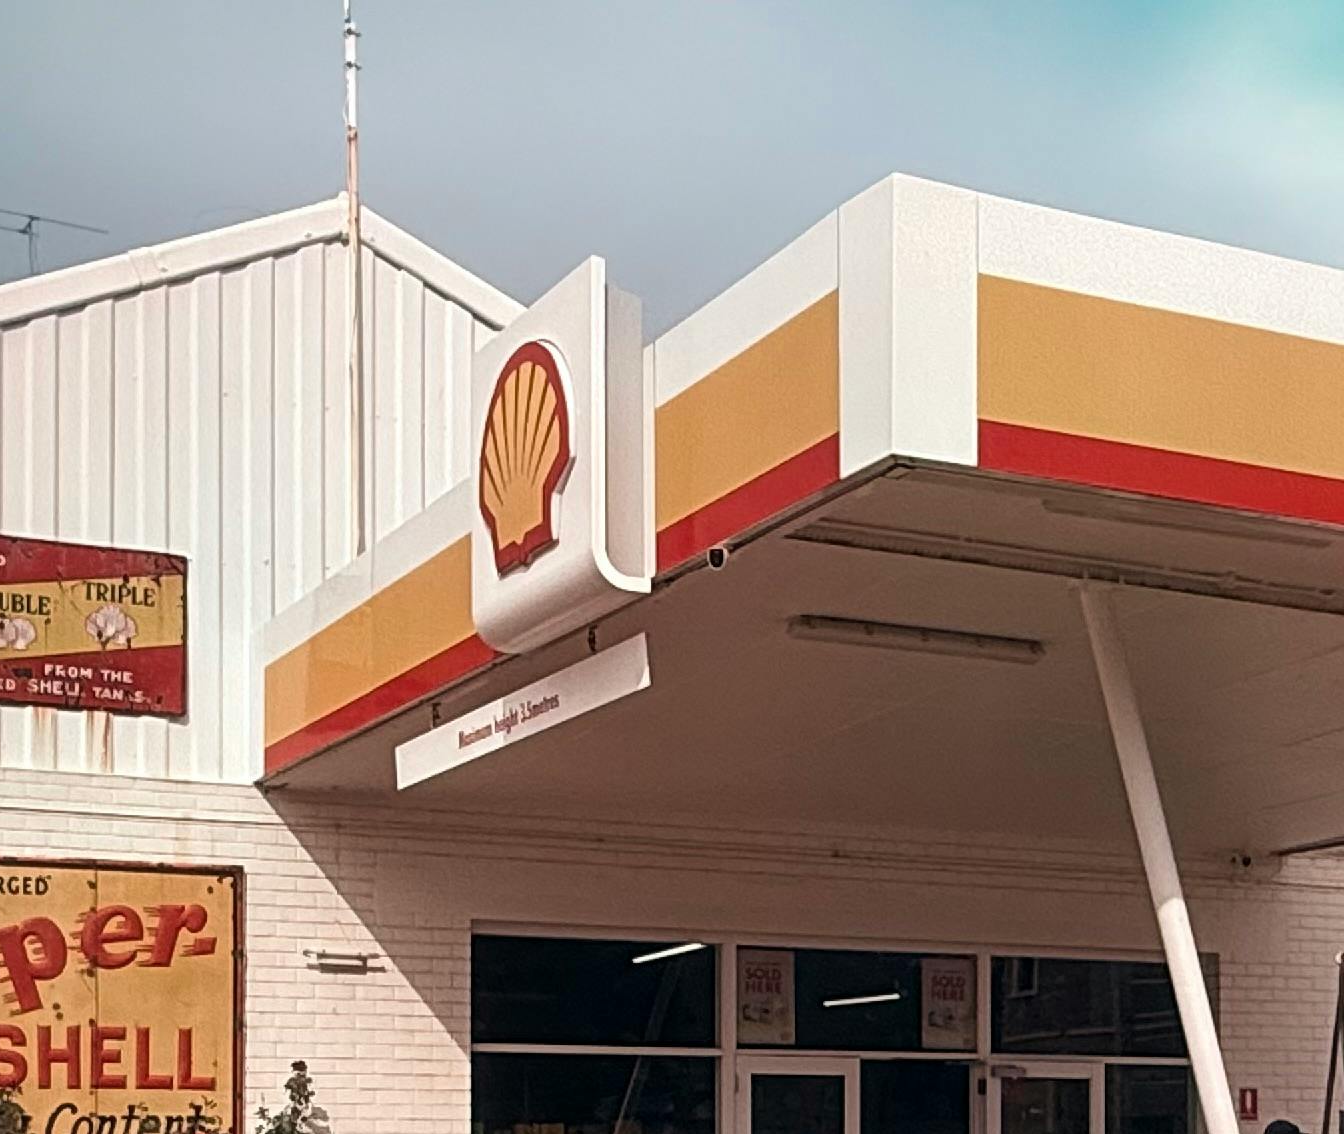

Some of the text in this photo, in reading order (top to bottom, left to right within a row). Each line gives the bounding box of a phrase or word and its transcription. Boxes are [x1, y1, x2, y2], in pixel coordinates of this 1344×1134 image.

[84, 581, 156, 608] TRIPLE
[44, 663, 134, 684] FROM THE
[745, 967, 782, 981] SOLD
